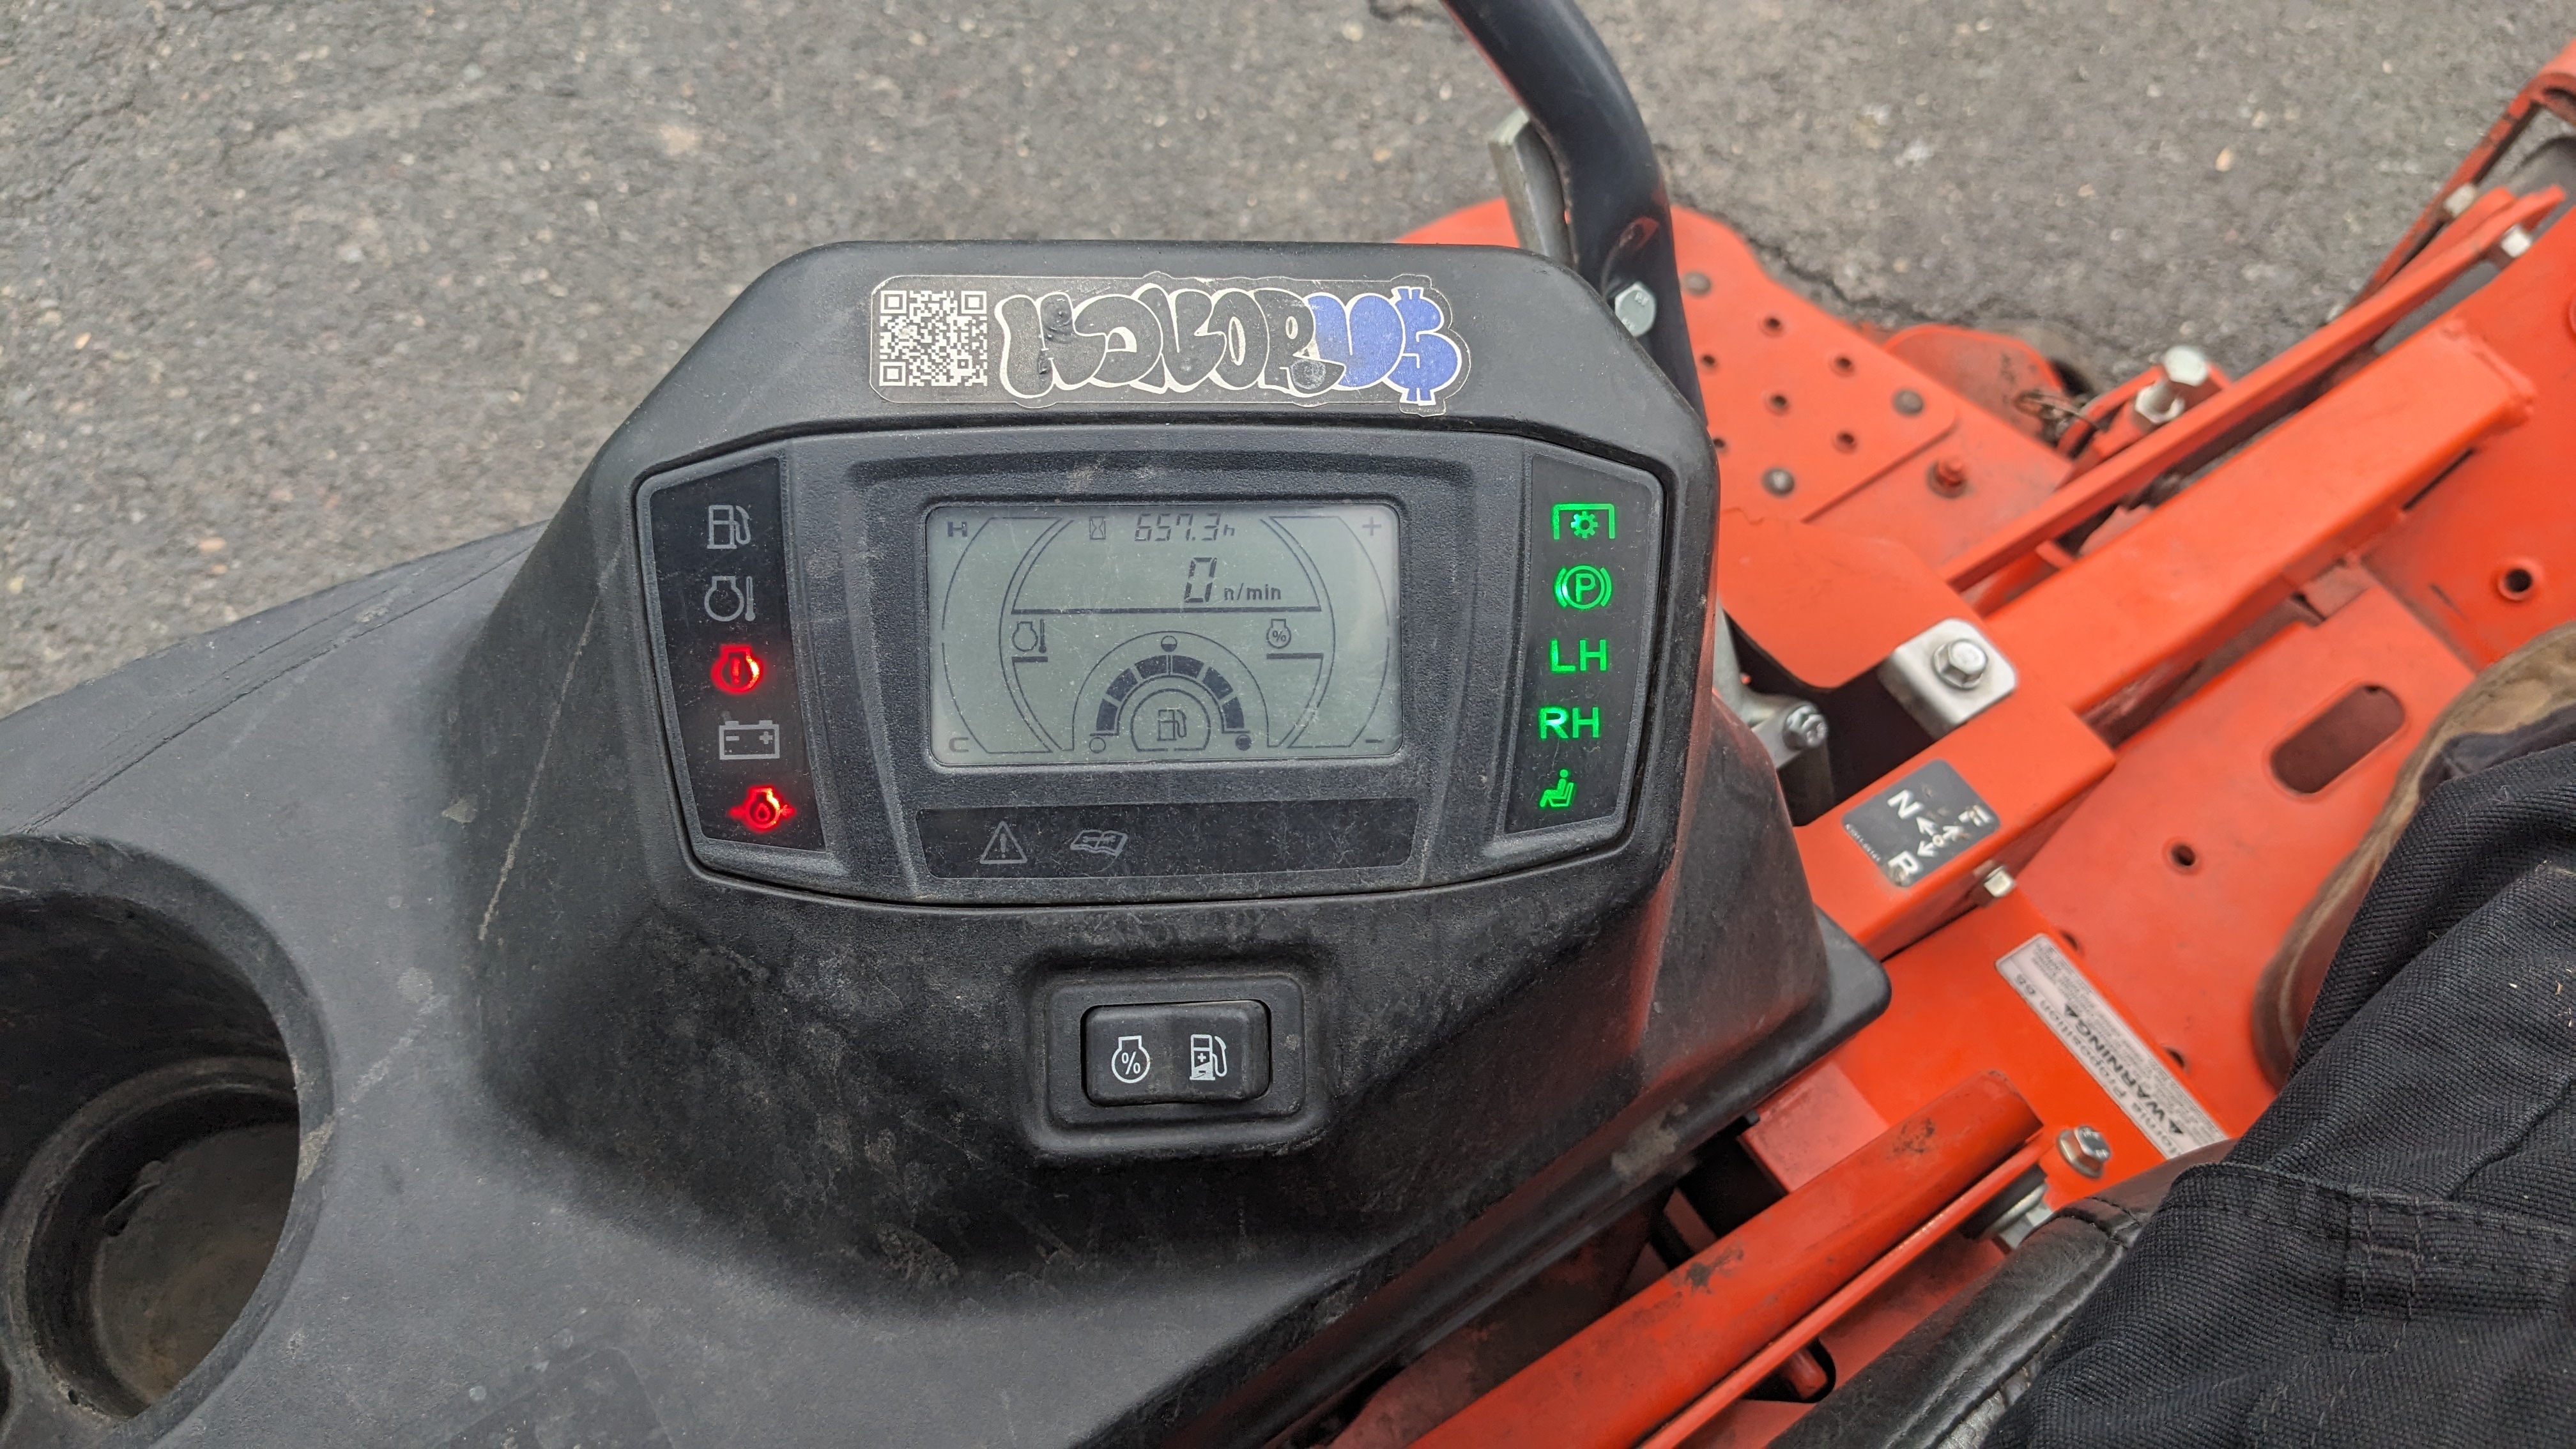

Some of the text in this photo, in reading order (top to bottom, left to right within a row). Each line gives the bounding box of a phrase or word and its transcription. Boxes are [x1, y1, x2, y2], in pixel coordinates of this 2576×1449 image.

[947, 522, 967, 537] H
[1223, 584, 1282, 601] n/min
[1575, 572, 1595, 603] P
[1549, 639, 1608, 673] LH
[1539, 707, 1600, 739] RH
[1887, 789, 1924, 820] N
[2040, 1000, 2126, 1098] Proposition
[2076, 1018, 2166, 1123] WARNING
